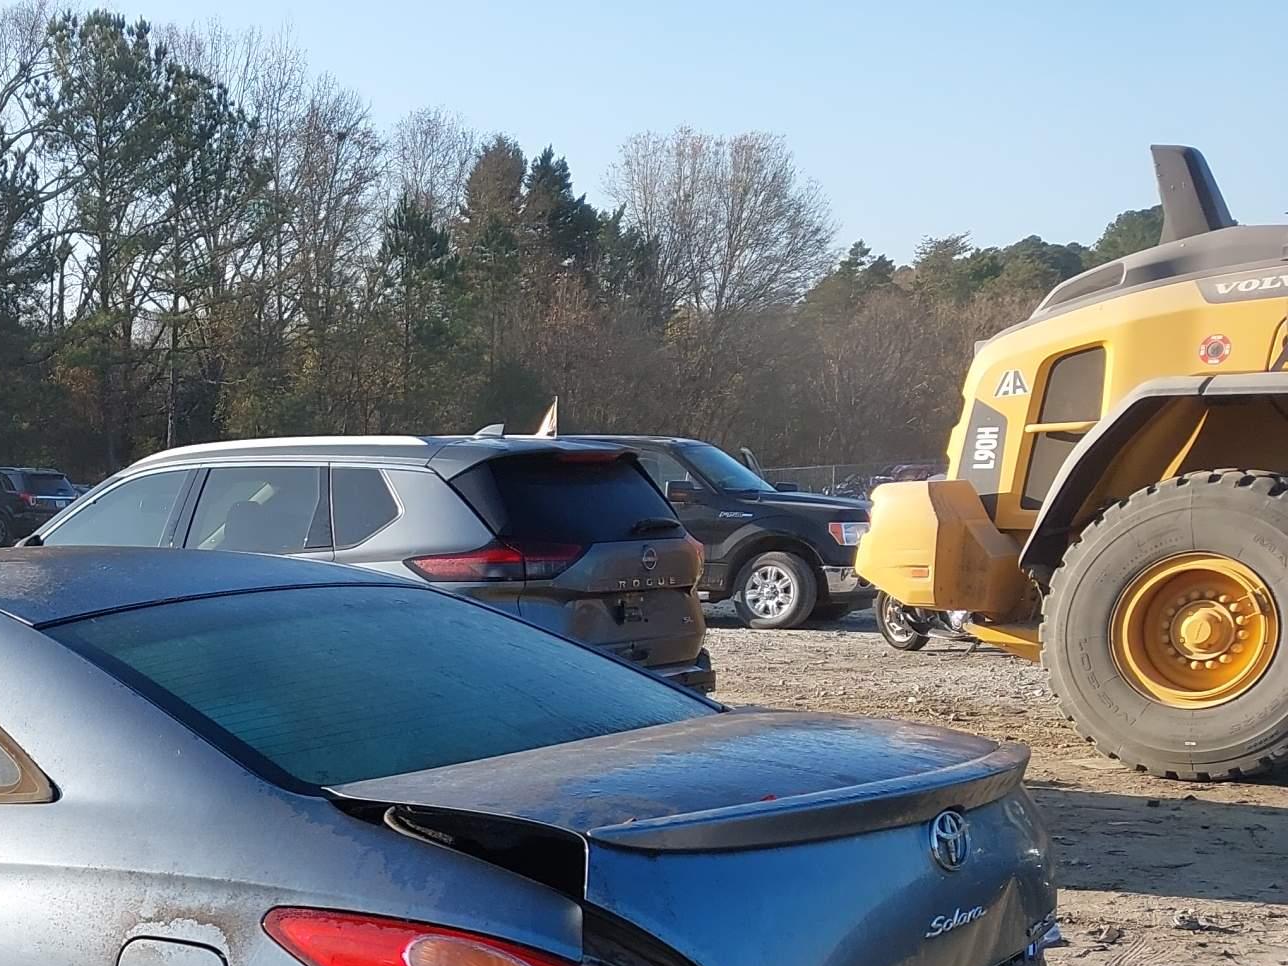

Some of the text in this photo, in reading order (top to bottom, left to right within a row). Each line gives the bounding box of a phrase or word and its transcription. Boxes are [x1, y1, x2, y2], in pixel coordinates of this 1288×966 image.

[972, 427, 999, 469] L90H
[618, 577, 676, 589] ROGUE
[924, 906, 988, 938] Solara
